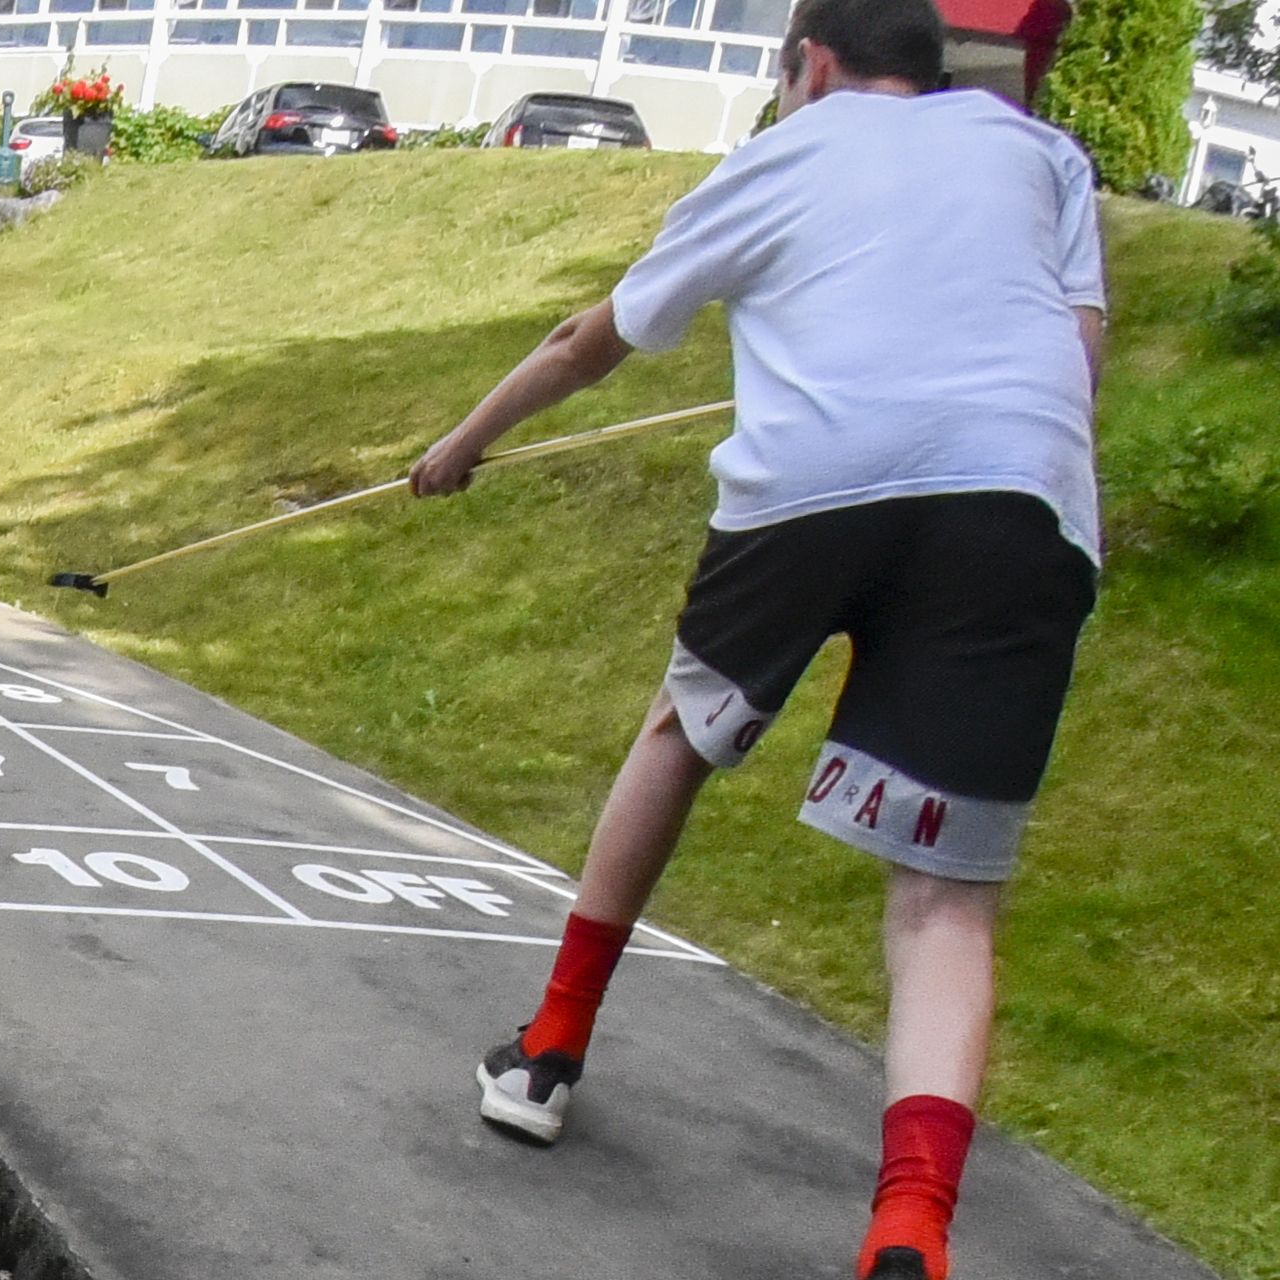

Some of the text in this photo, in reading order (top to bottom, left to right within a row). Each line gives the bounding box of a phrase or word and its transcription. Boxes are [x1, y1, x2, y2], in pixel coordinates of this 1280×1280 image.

[124, 761, 201, 792] 7
[12, 847, 514, 918] 10 OFF
